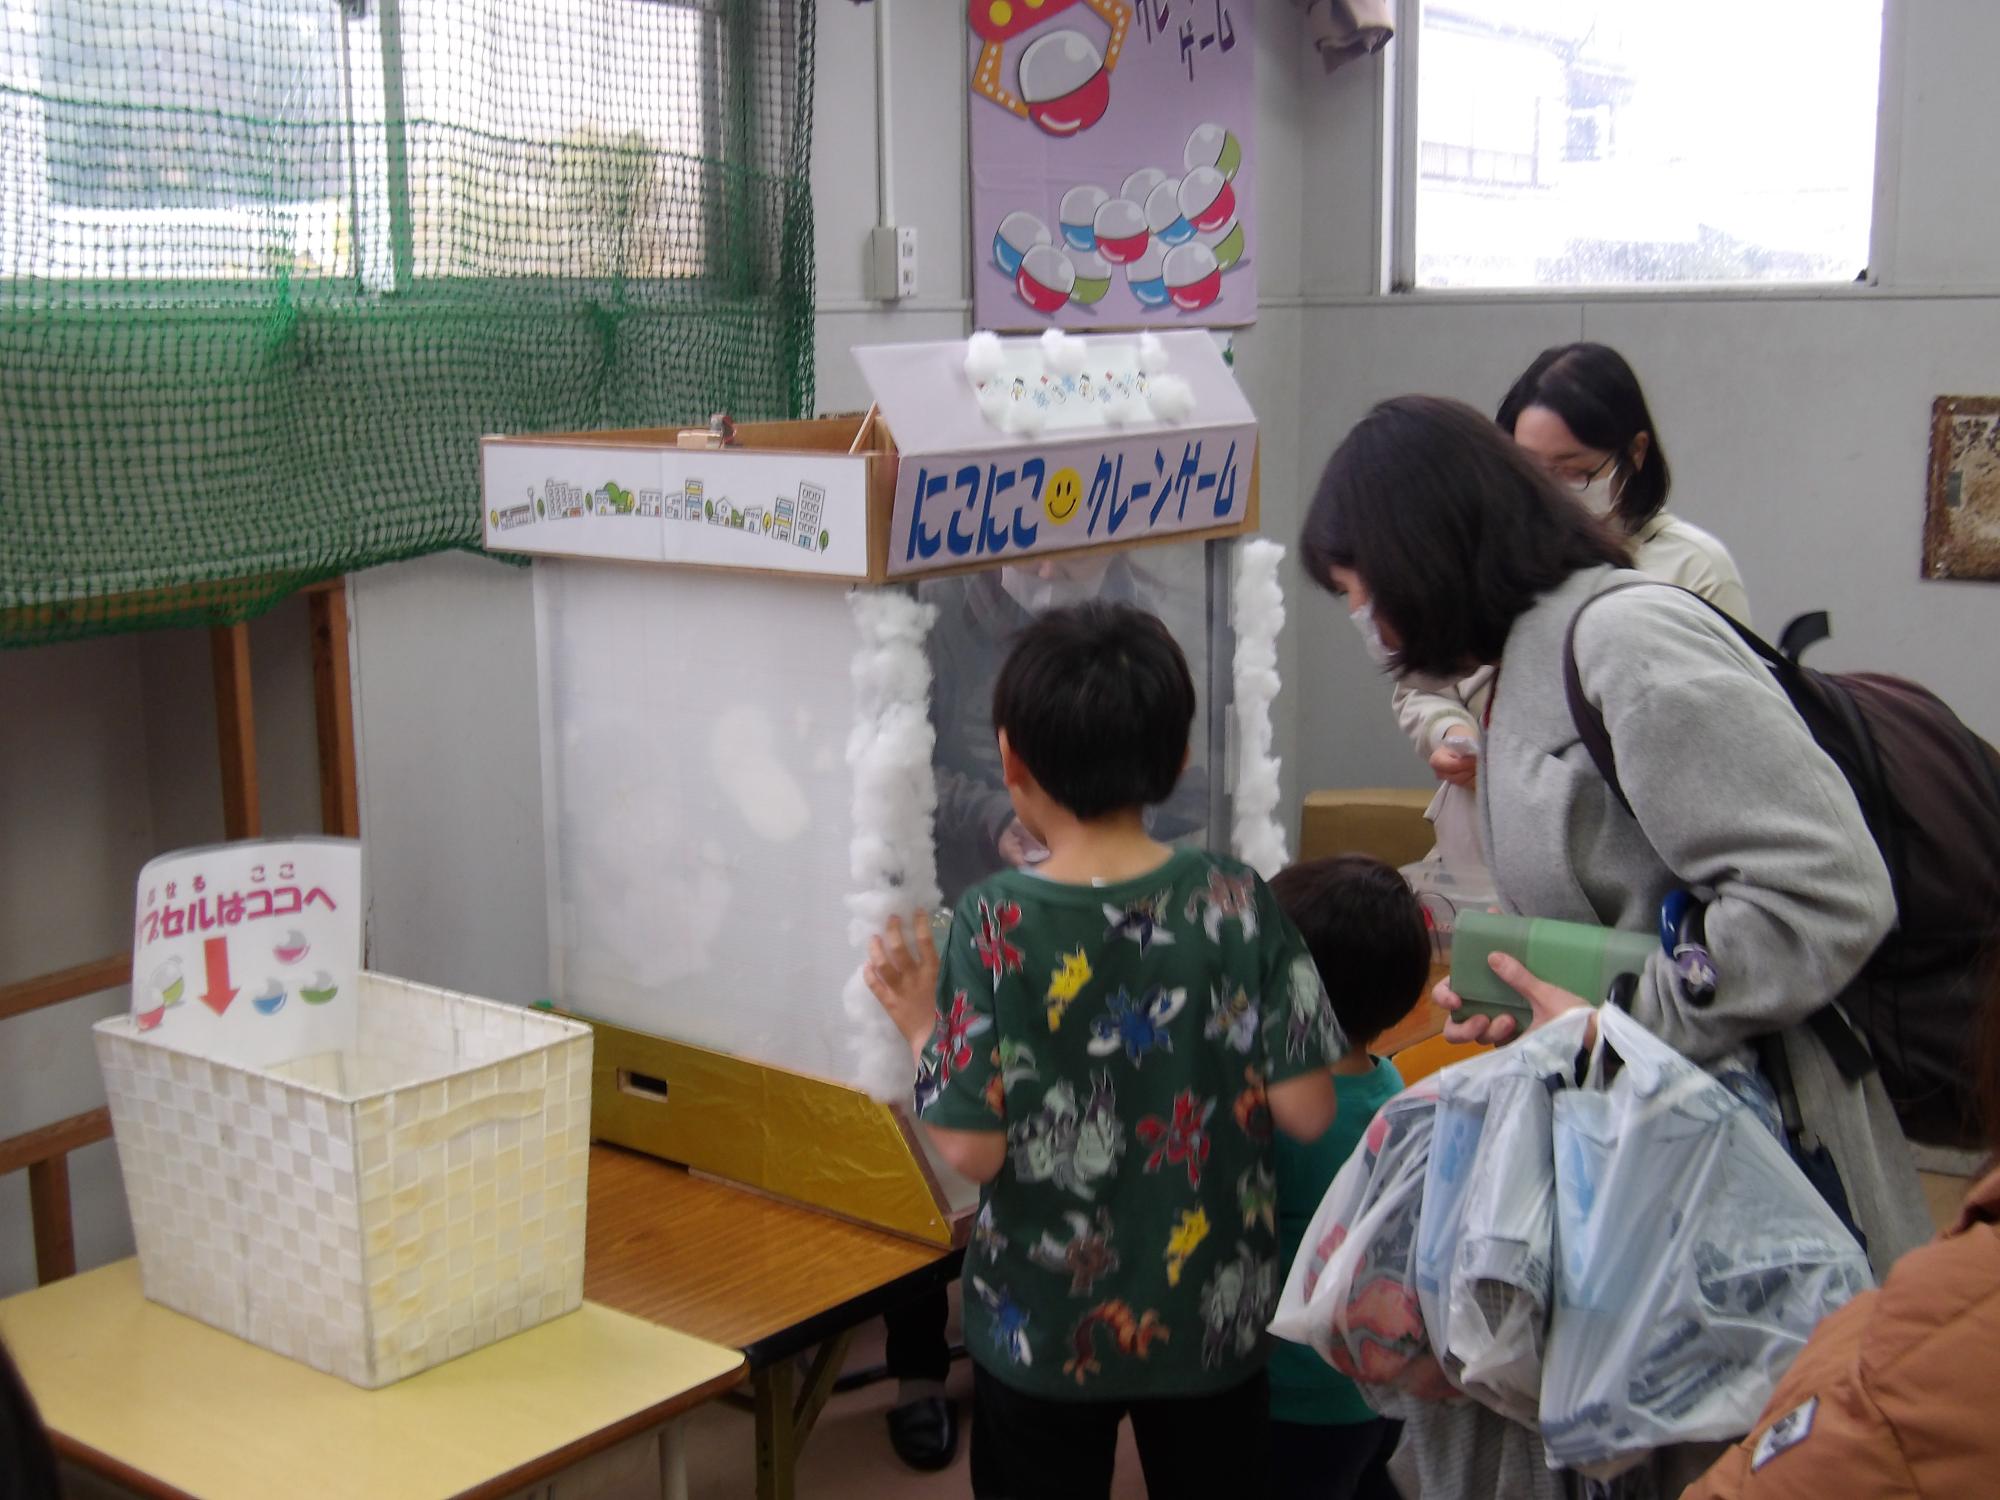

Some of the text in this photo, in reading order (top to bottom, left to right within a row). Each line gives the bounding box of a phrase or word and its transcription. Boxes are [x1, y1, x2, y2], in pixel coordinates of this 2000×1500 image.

[906, 439, 1237, 563] にこにこ クレーンゲーム
